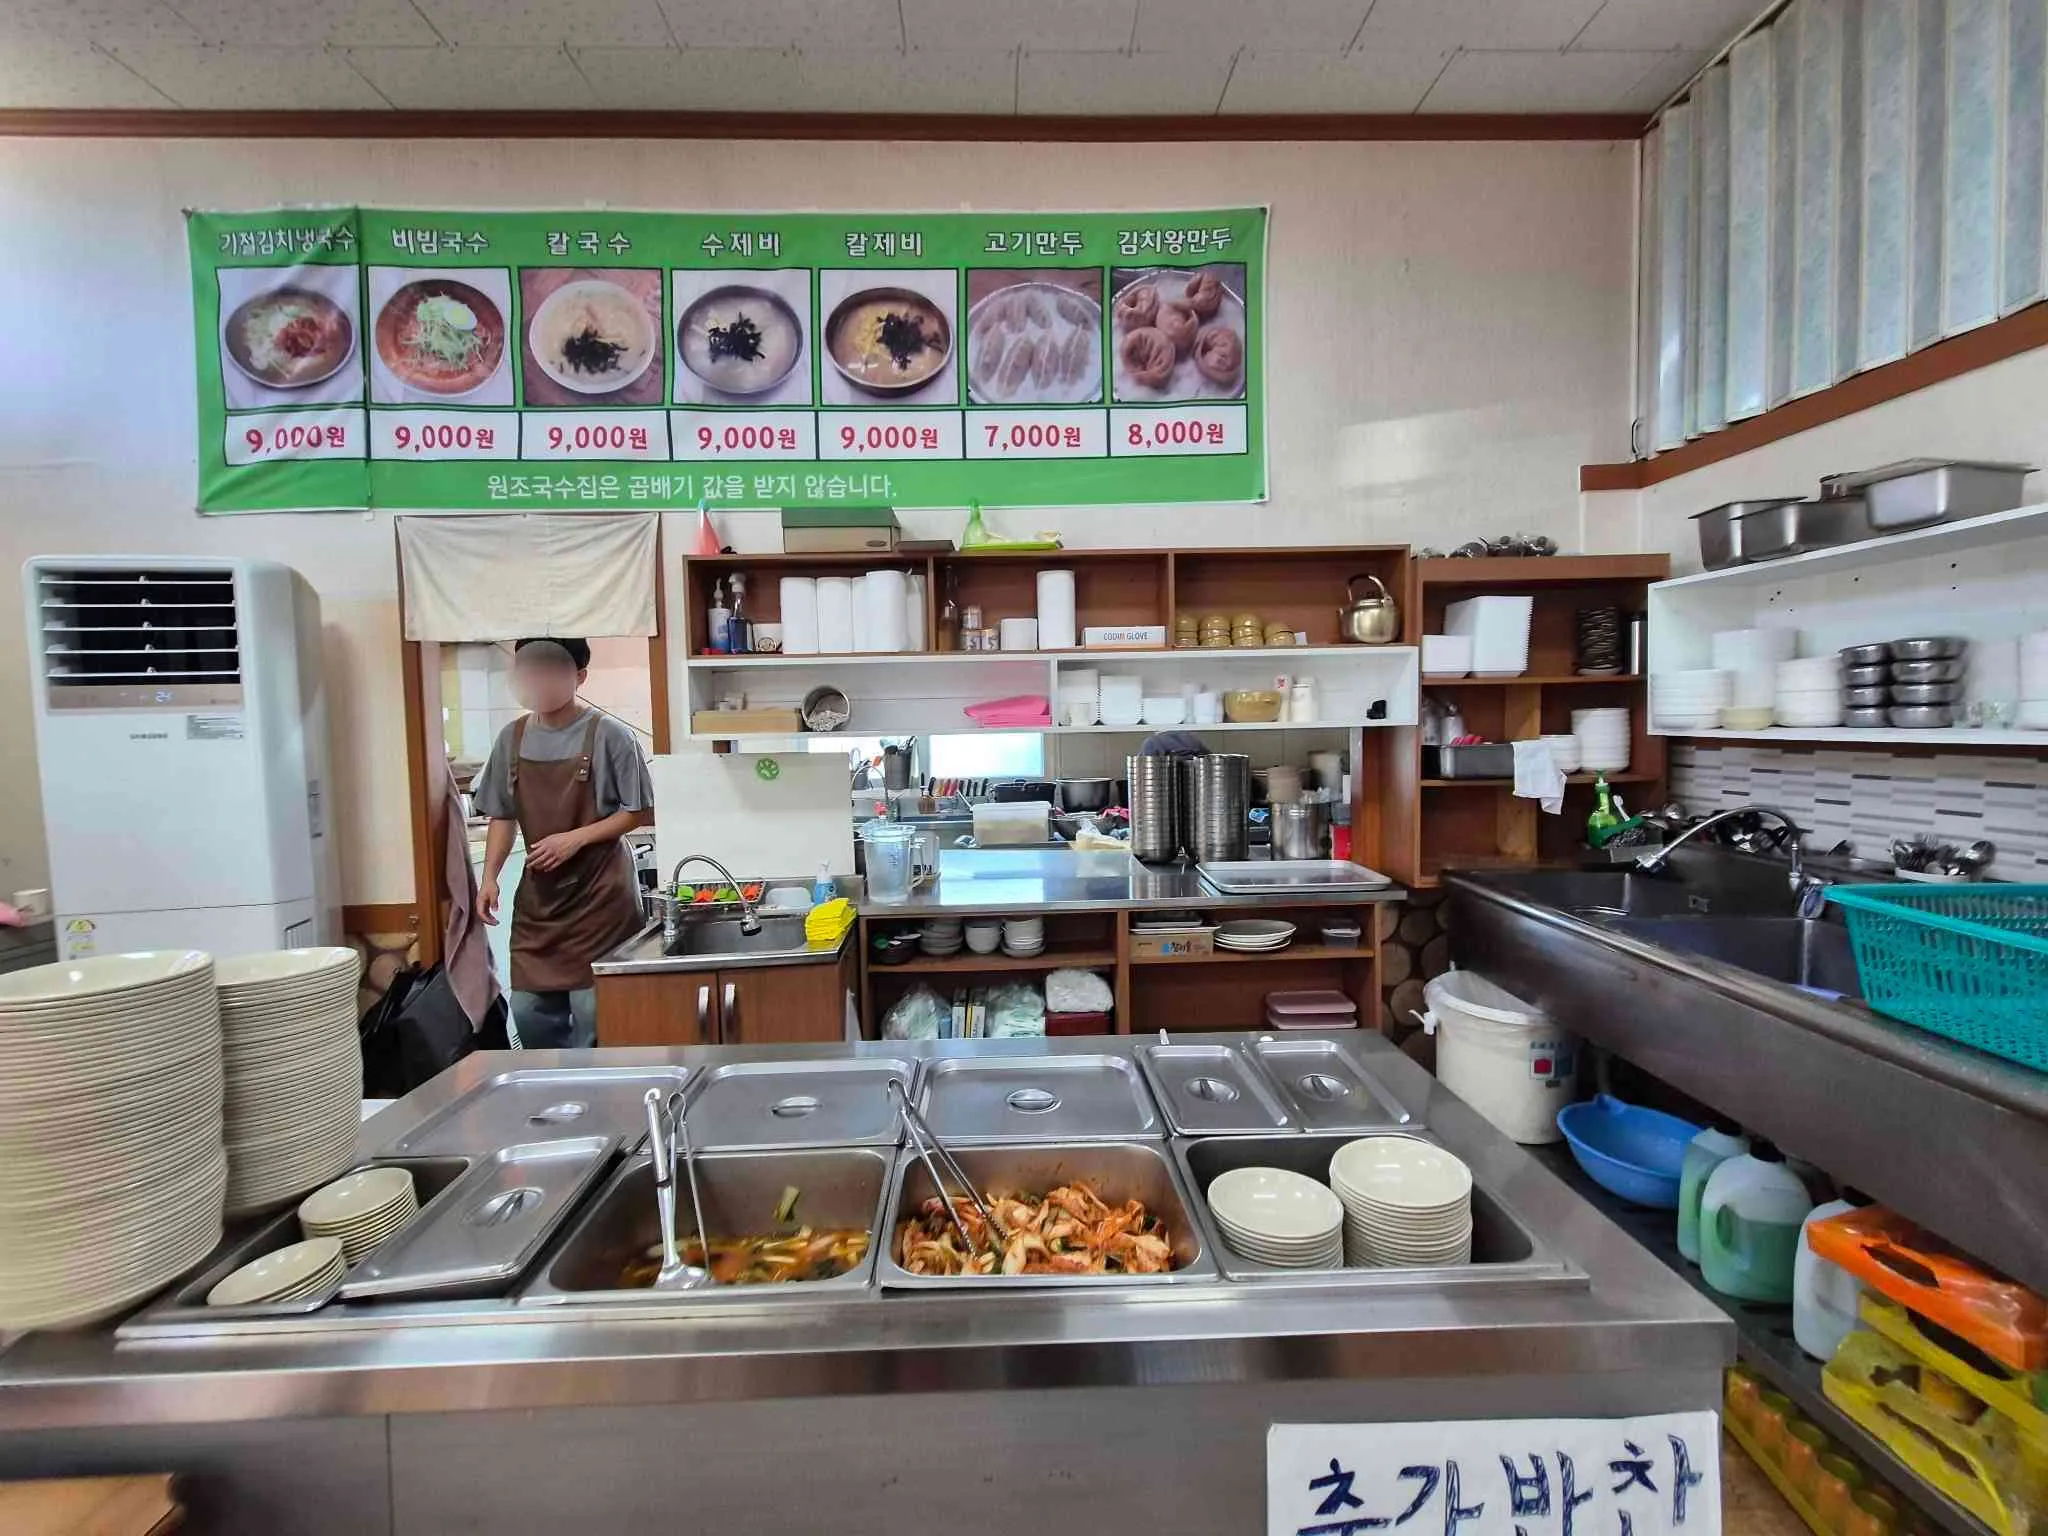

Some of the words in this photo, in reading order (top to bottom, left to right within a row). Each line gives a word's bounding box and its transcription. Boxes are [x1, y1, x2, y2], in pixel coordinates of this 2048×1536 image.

[390, 228, 489, 256] 비빔국수
[701, 232, 782, 257] 수제비
[845, 231, 924, 257] 칼제비
[983, 230, 1084, 257] 고기만두
[1117, 226, 1233, 255] 김치왕만두
[245, 425, 346, 454] 9,000원
[394, 425, 494, 451] 9,000원
[548, 425, 649, 451] 9,000원
[697, 425, 797, 451] 9,000원
[840, 425, 940, 451] 9,000원
[984, 423, 1081, 450] 7,000원
[1127, 421, 1224, 448] 8,000원
[486, 474, 622, 500] 원조국수집은
[626, 474, 695, 501] 곱배기
[702, 474, 746, 499] 값을
[753, 474, 797, 500] 받지
[803, 474, 899, 500] 않습니다.
